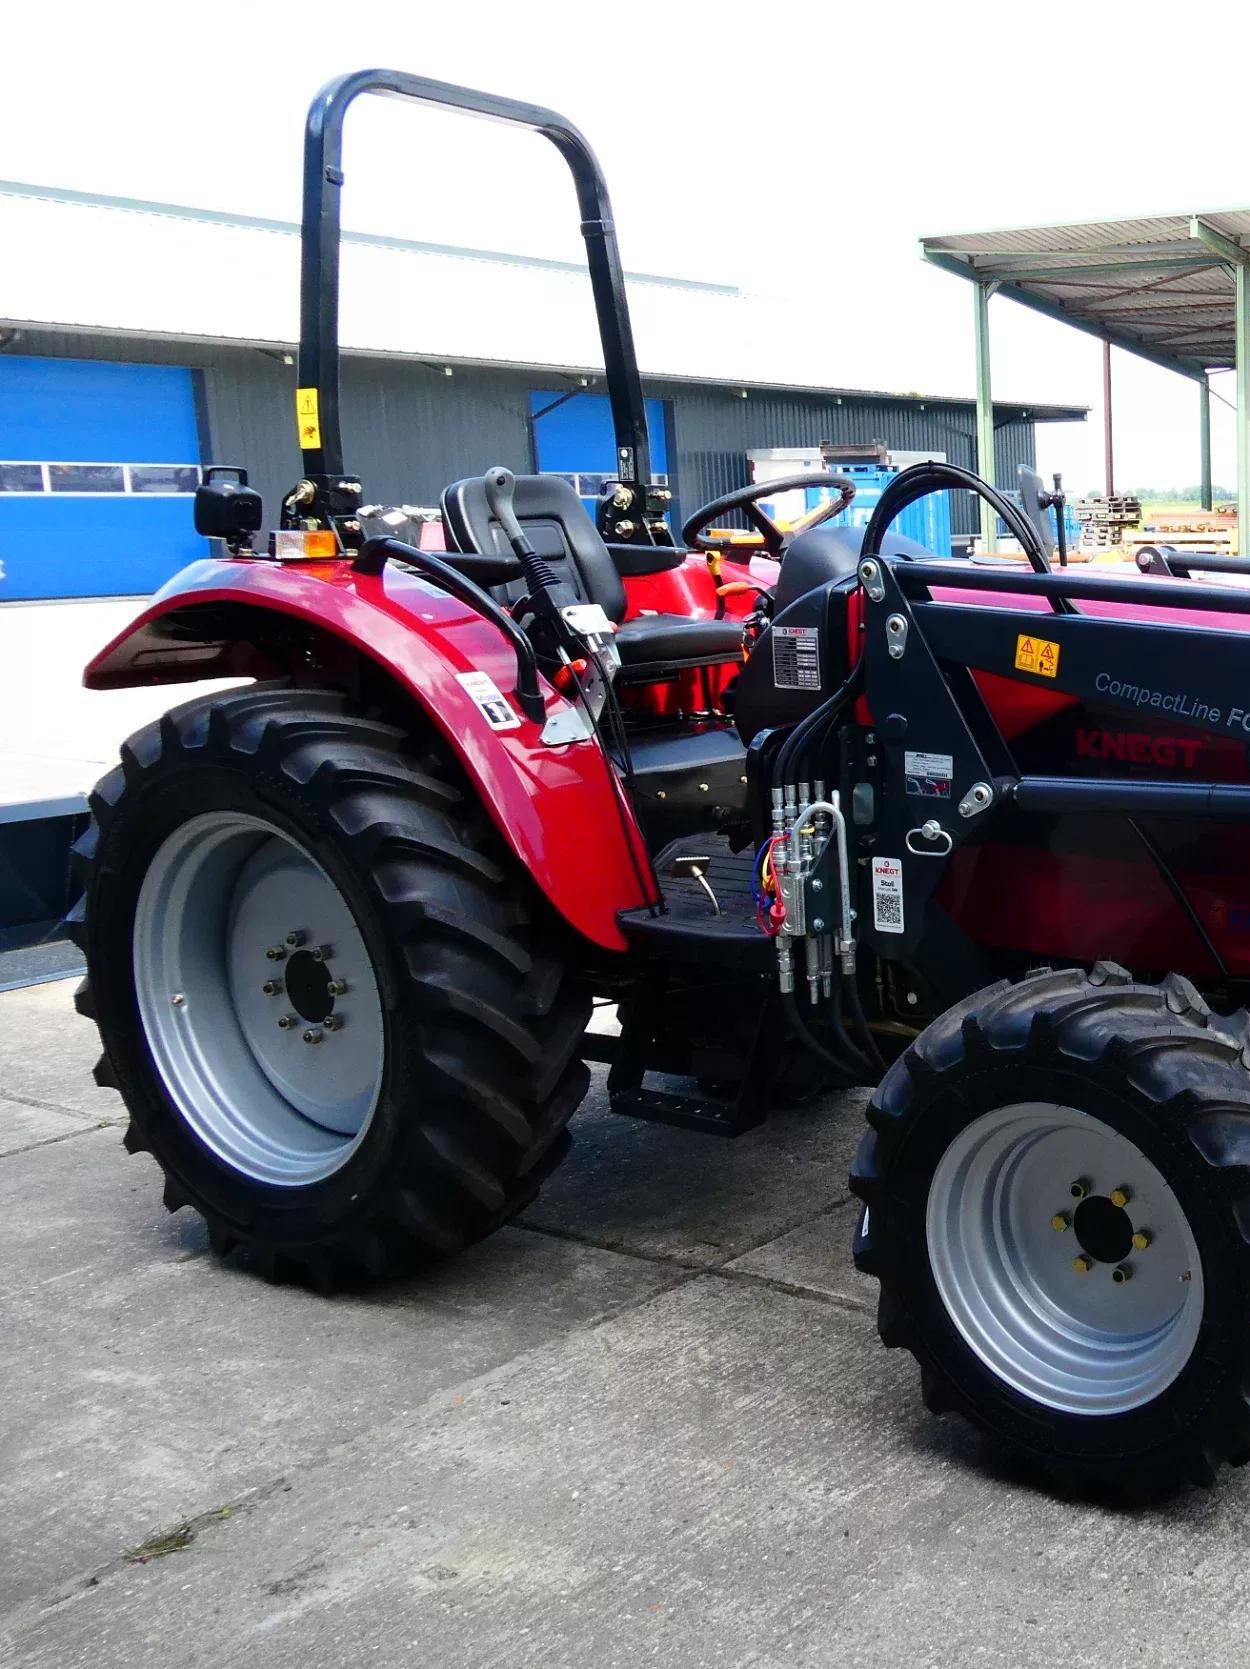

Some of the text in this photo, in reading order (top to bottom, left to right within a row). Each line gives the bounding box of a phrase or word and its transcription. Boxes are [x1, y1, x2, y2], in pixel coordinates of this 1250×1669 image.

[1095, 672, 1221, 722] CompactLine
[1075, 727, 1205, 768] KNEGT
[875, 866, 899, 875] KNEGT
